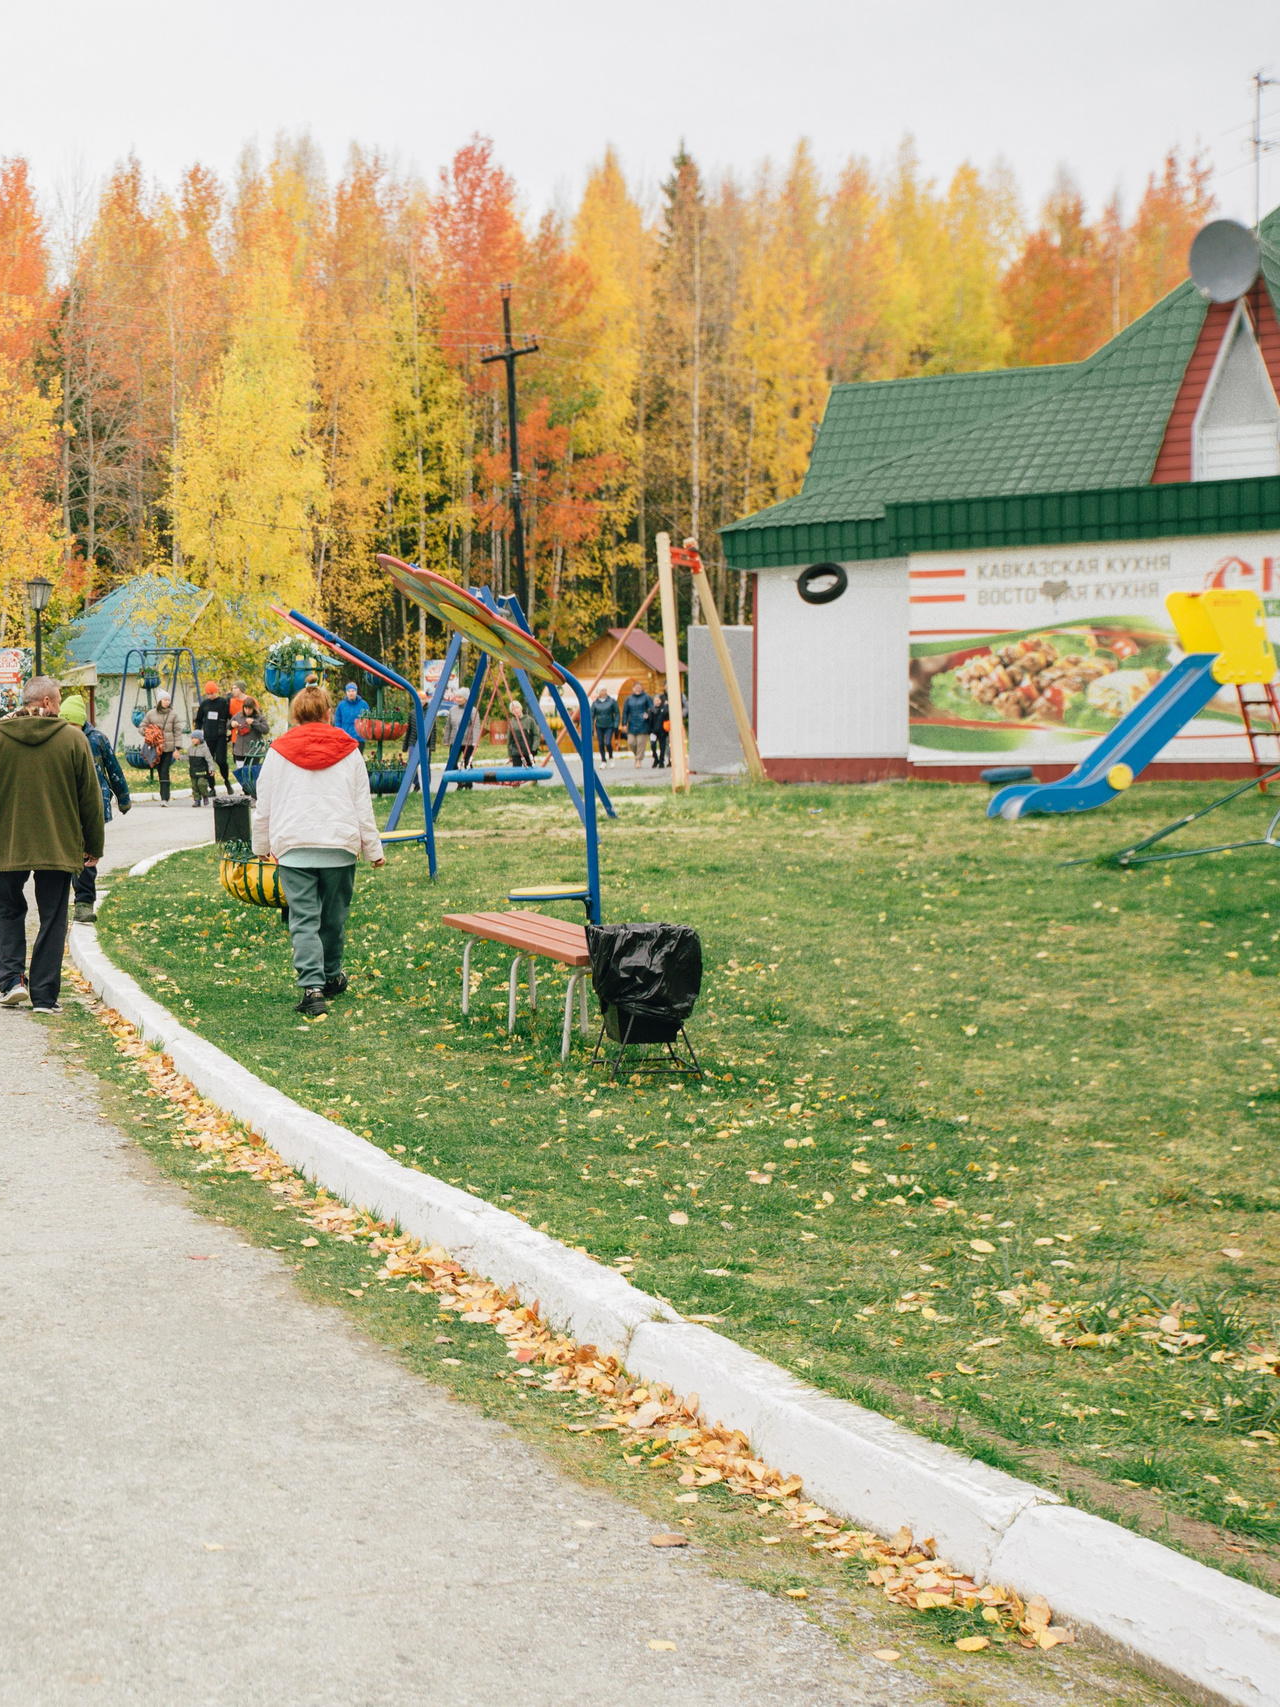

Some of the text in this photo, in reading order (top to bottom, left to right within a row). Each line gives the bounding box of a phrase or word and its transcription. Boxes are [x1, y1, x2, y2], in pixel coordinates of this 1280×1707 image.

[976, 554, 1171, 580] КАВКАЗСКАЯ КУХНЯ
[976, 581, 1160, 606] ВОСТОАЯ КУХНЯ
